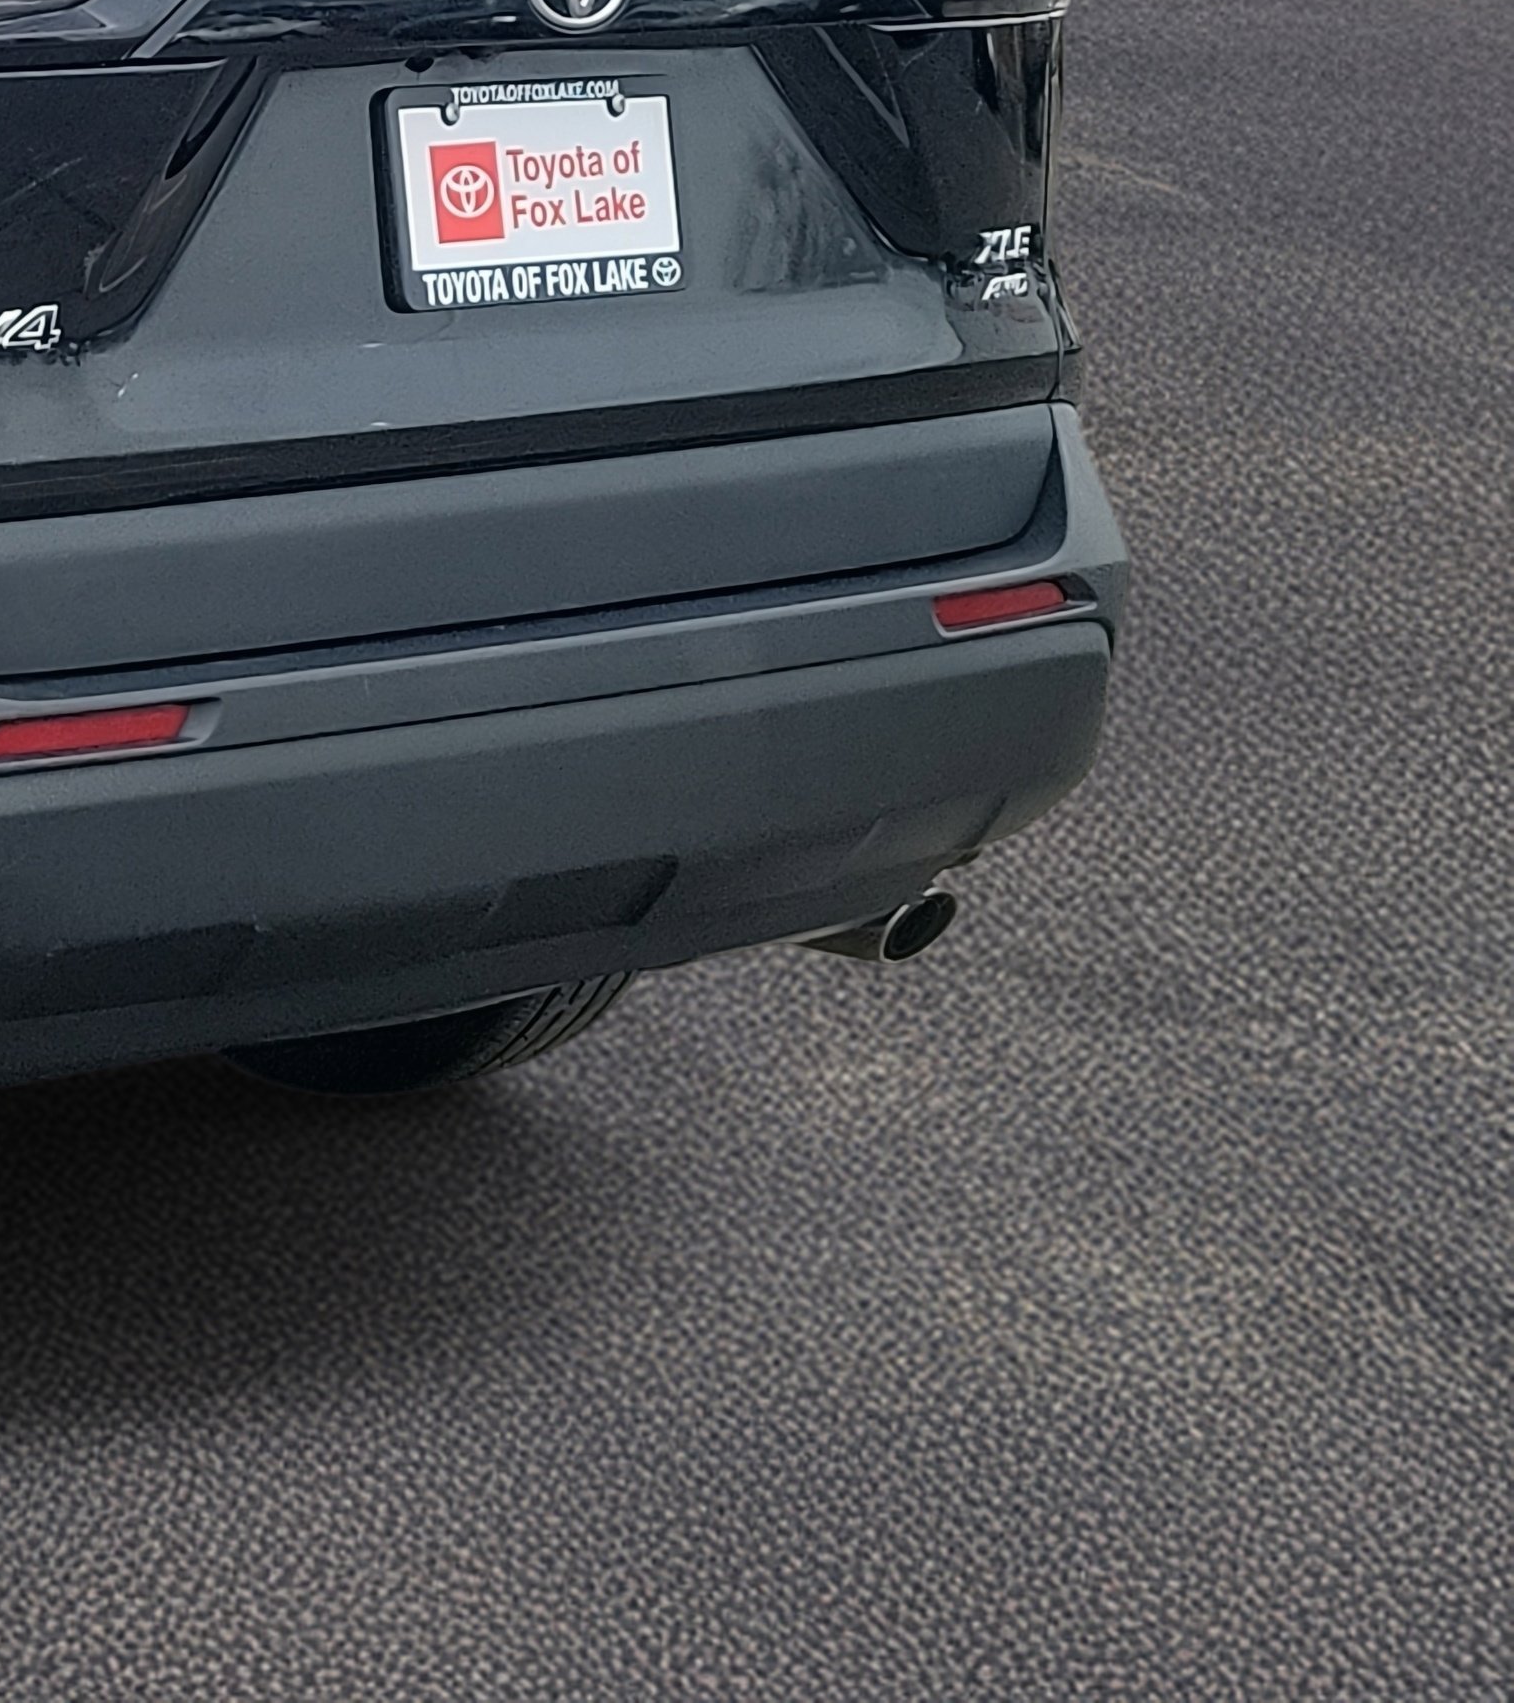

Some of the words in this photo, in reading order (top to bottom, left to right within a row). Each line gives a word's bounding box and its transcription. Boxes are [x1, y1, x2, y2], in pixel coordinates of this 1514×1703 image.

[506, 144, 604, 190] Toyota
[613, 141, 642, 174] of
[511, 193, 567, 229] Fox
[575, 187, 647, 223] Lake
[422, 267, 510, 306] TOYOTA
[512, 266, 542, 298] OF
[545, 262, 590, 296] FOX
[592, 257, 649, 293] LAKE
